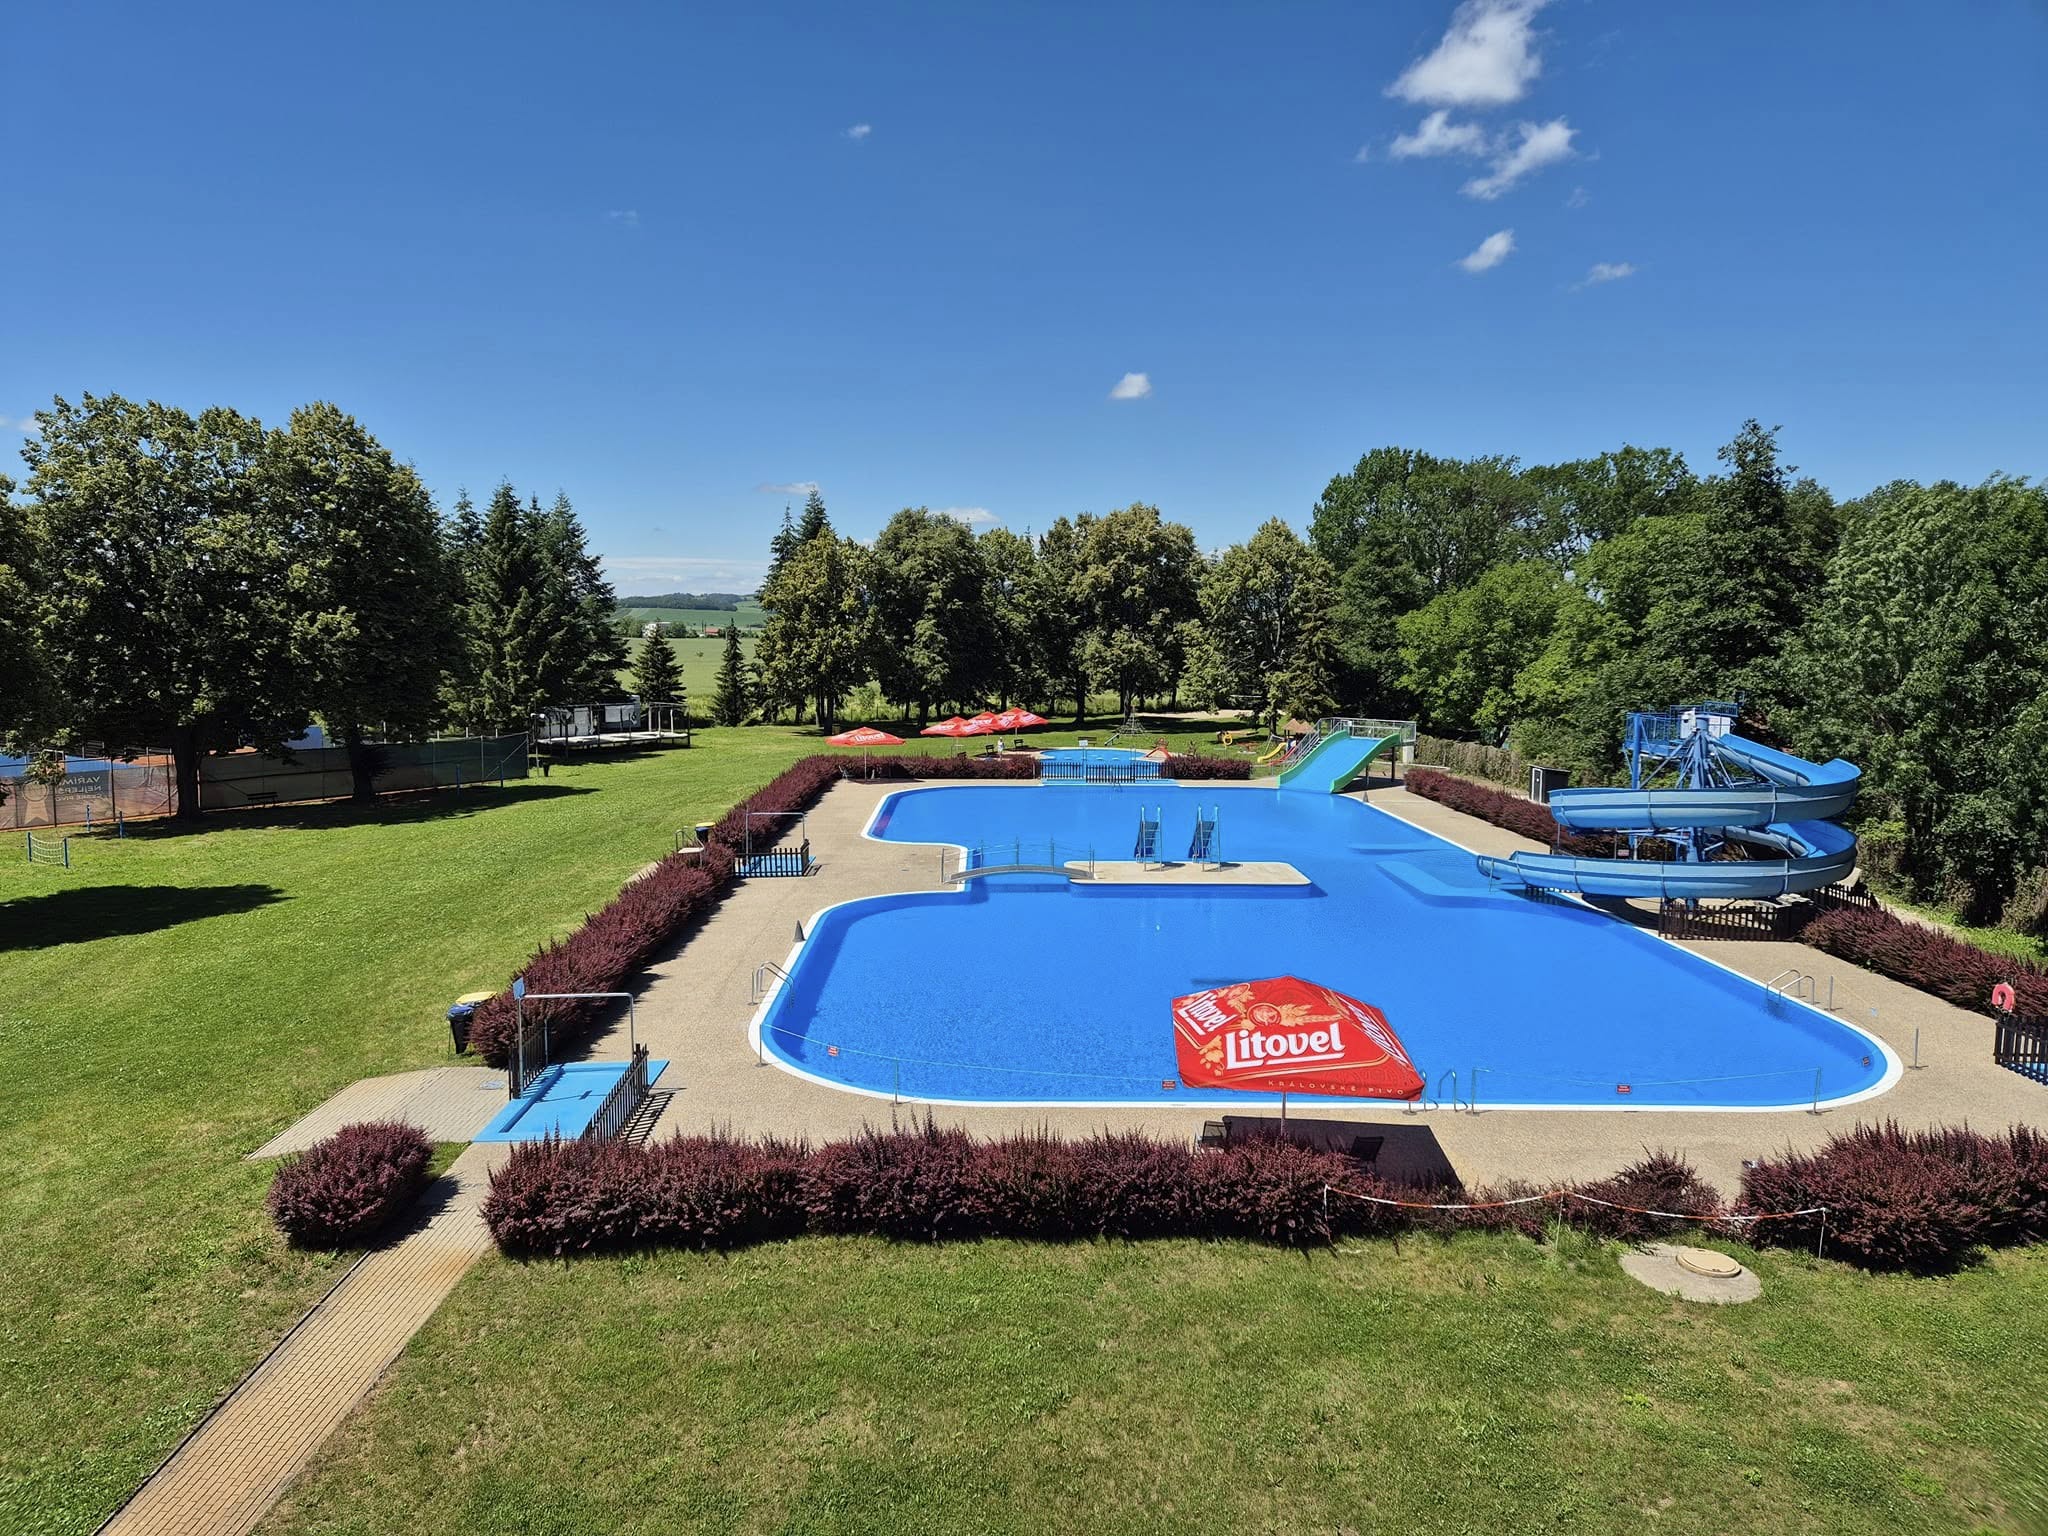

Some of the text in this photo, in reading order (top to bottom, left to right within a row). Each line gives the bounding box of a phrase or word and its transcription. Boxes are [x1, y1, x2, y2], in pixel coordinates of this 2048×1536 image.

[1178, 992, 1239, 1036] Litovel
[1225, 1022, 1346, 1070] Litovel
[1267, 1079, 1404, 1096] KRÁLOVSKÉ PIVO
